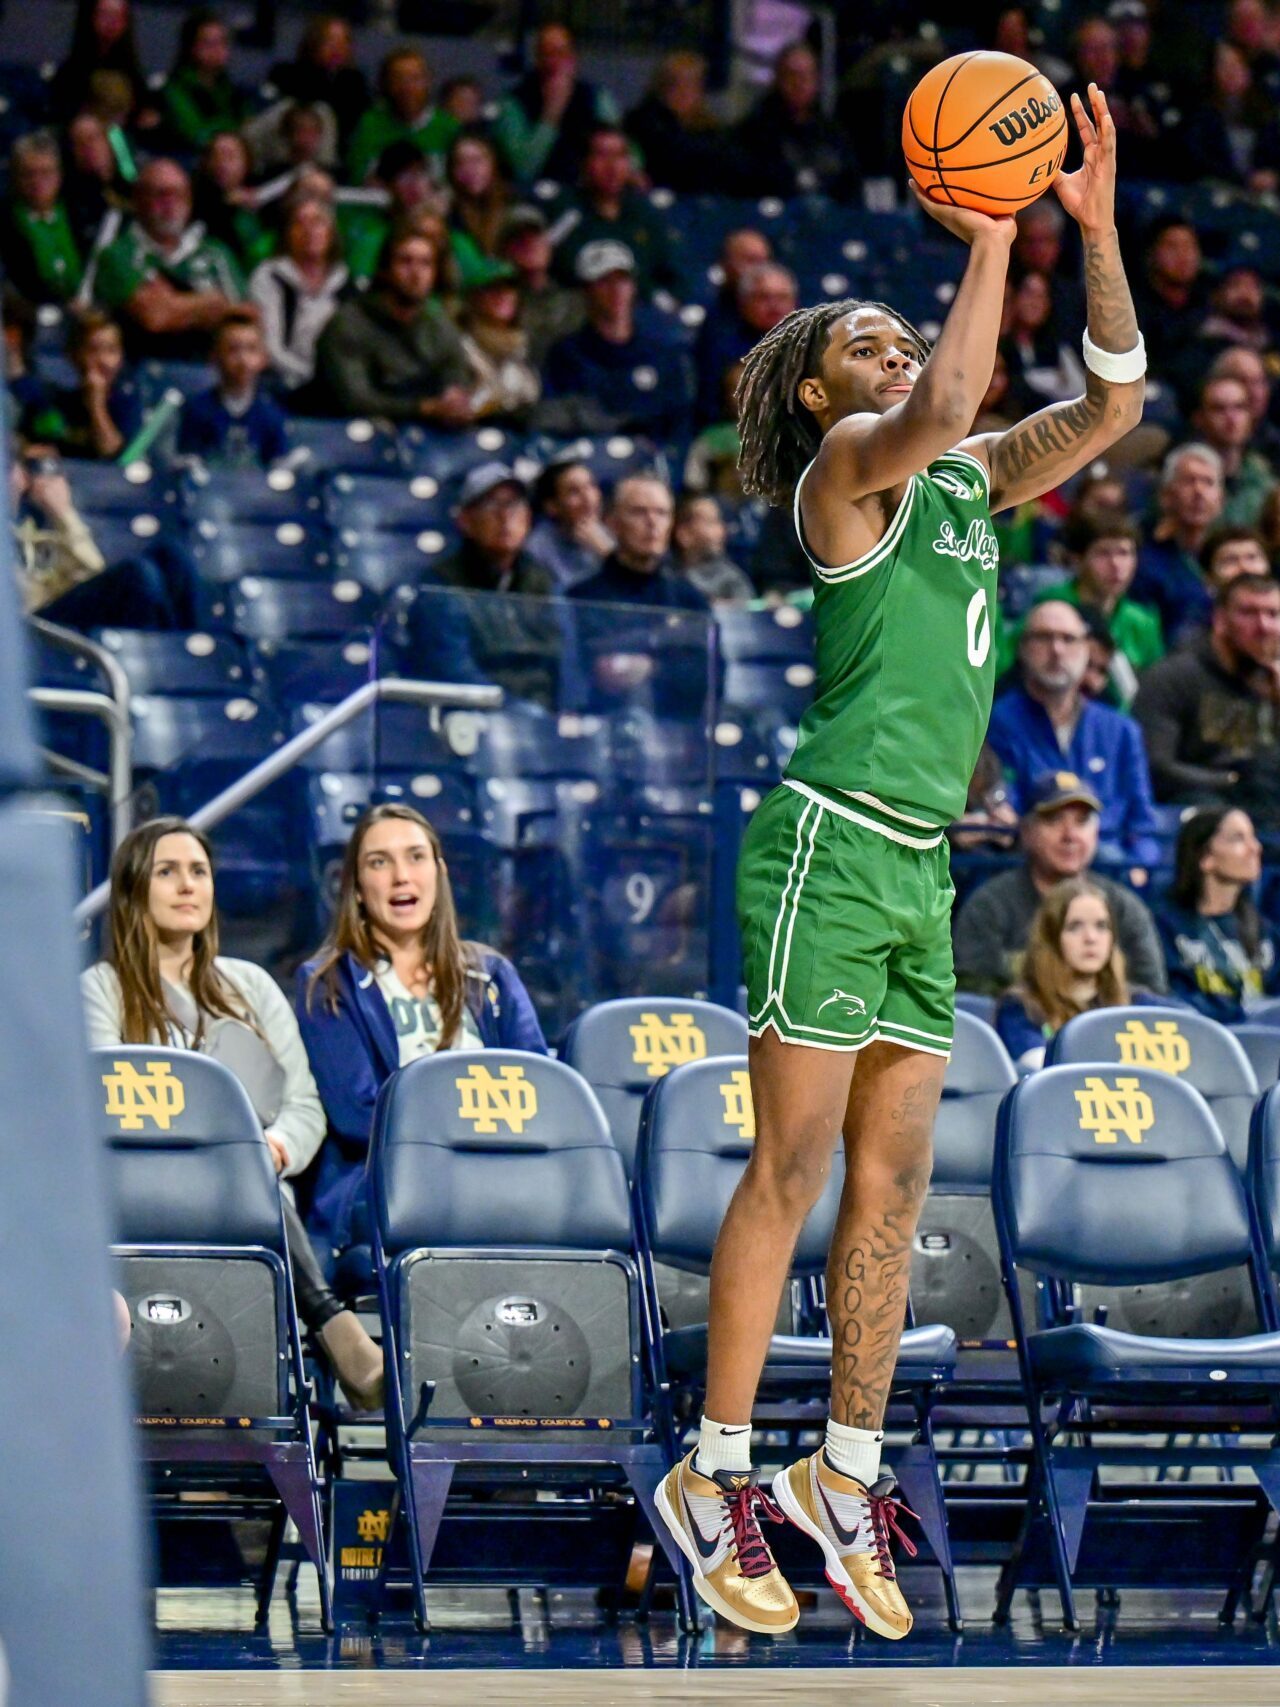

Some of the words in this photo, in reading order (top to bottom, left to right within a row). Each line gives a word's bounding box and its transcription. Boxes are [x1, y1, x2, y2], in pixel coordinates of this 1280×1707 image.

[988, 91, 1062, 147] Wilso
[966, 588, 990, 667] 0
[625, 872, 655, 924] 9
